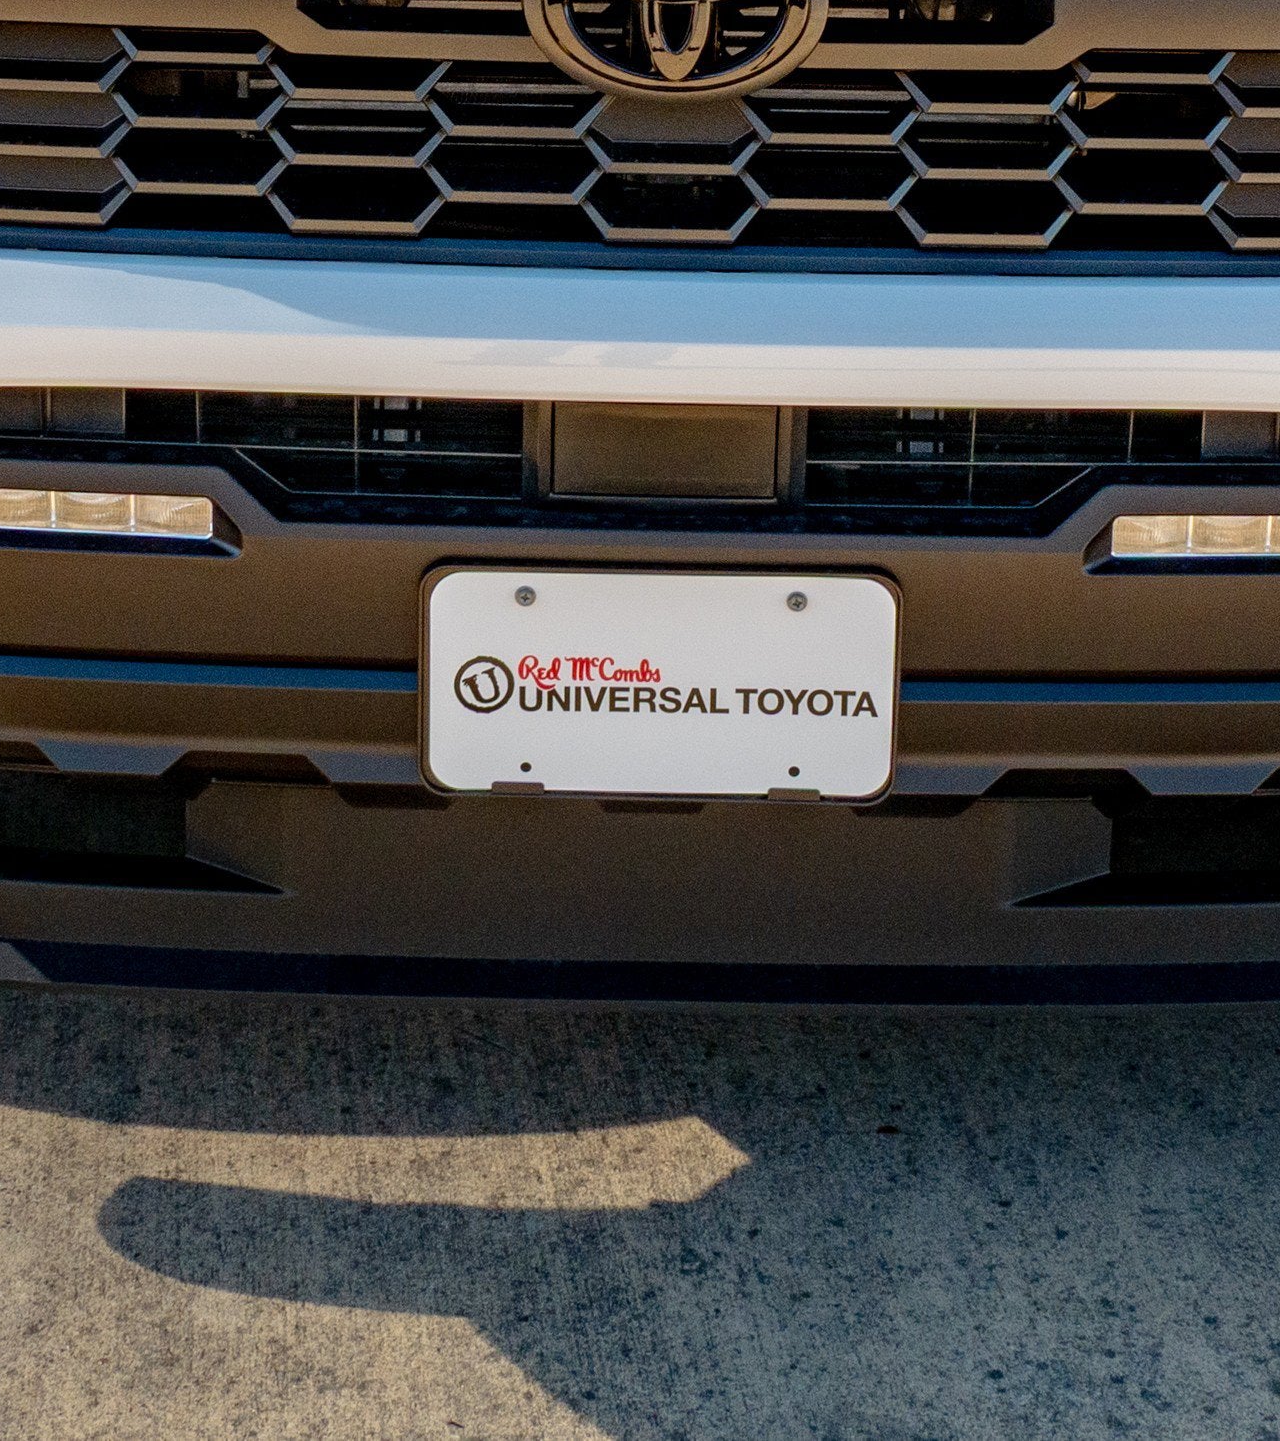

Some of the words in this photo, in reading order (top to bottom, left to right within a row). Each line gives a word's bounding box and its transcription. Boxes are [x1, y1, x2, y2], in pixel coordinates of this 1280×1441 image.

[518, 654, 561, 690] Red
[565, 655, 662, 683] McCombs
[519, 685, 730, 715] UNIVERSAL
[735, 687, 879, 718] TOYOTA
